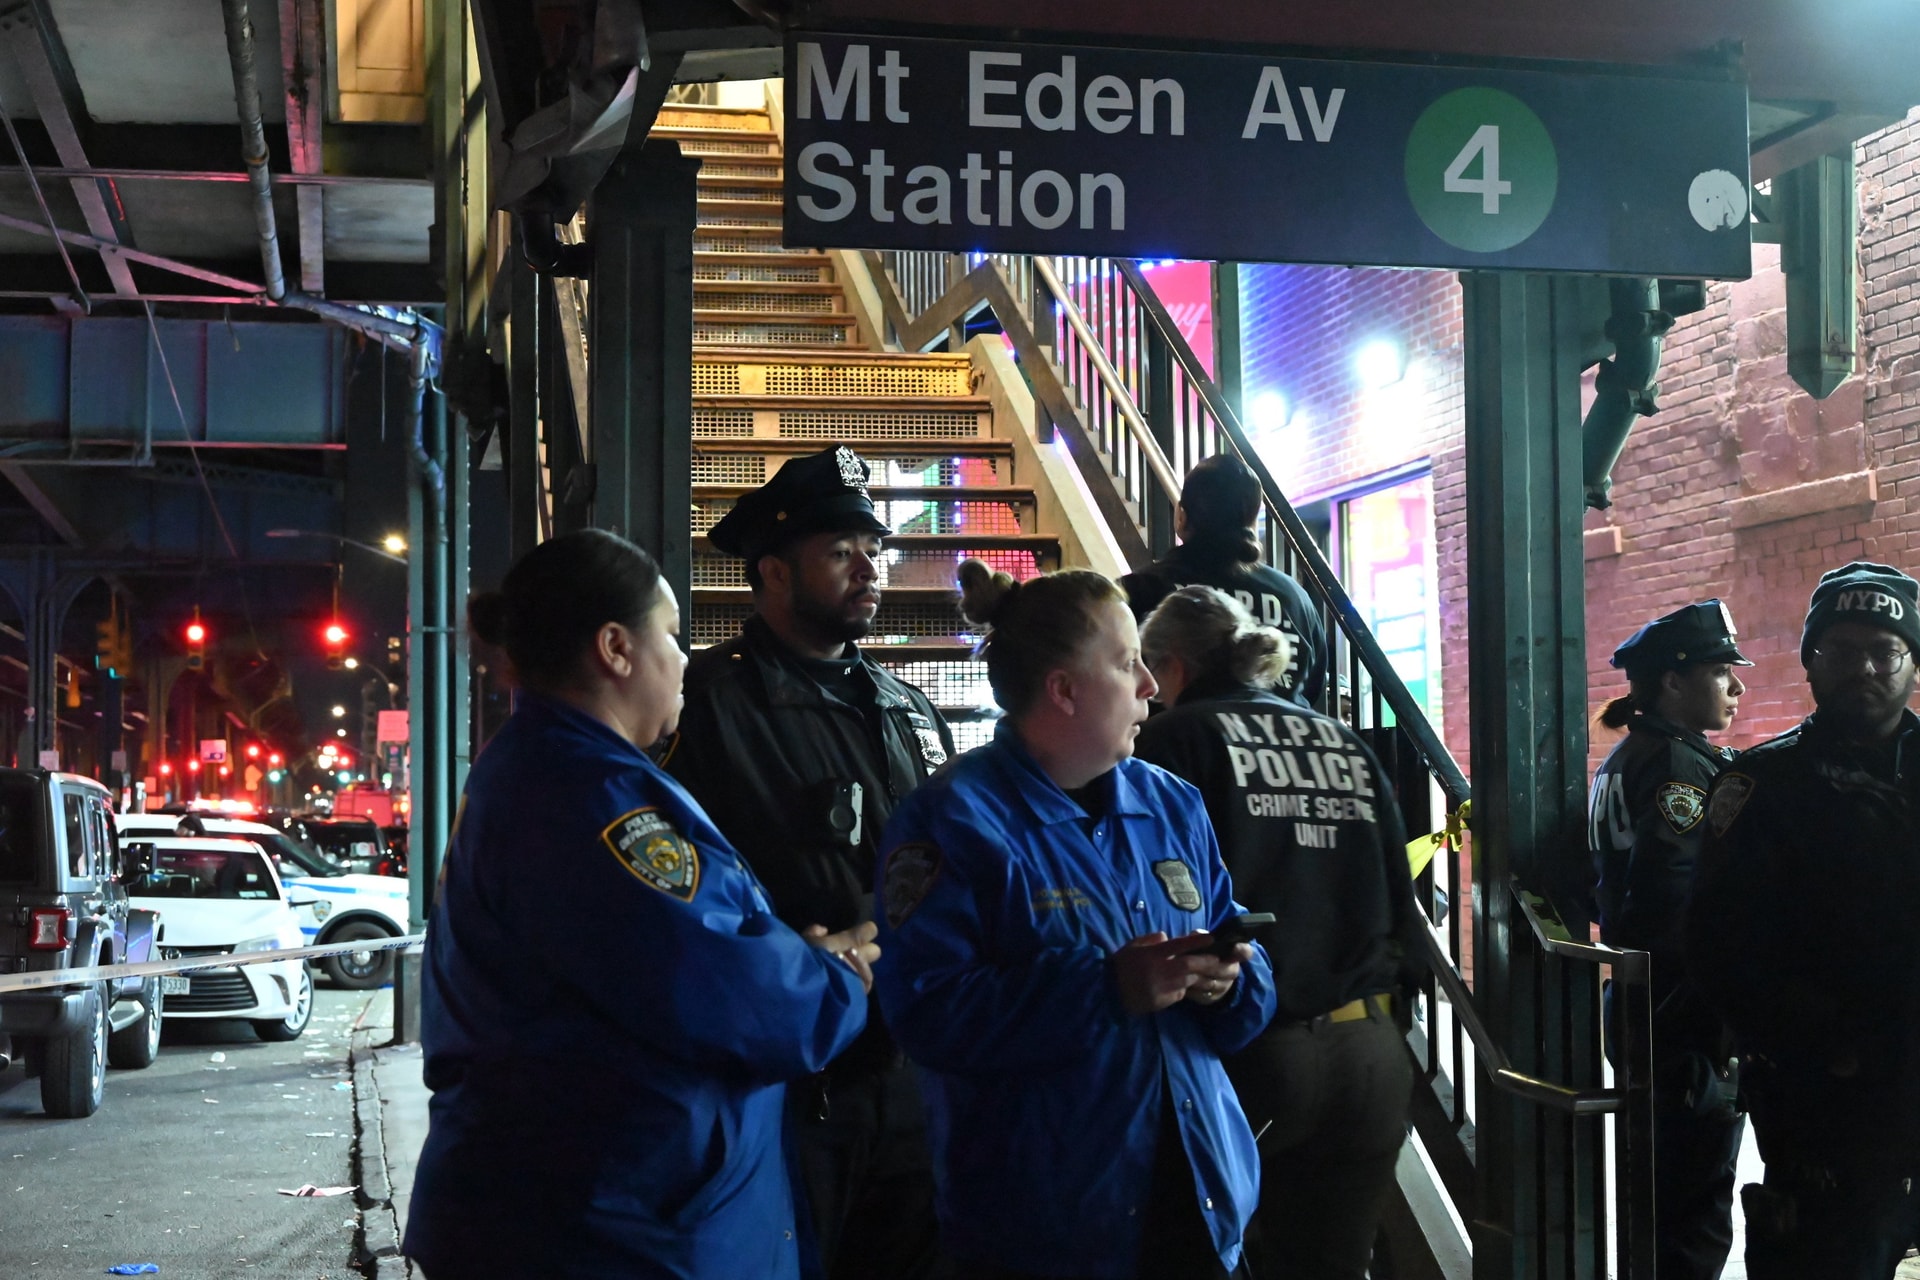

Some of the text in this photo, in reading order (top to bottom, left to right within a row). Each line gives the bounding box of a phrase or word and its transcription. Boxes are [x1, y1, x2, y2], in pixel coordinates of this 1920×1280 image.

[796, 42, 1346, 142] Mt Eden Av
[796, 141, 1126, 231] Station
[1444, 124, 1512, 214] 4
[1835, 589, 1904, 620] NYPD
[1216, 712, 1357, 751] N.Y.P.D.
[1226, 744, 1376, 798] POLICE
[1246, 793, 1377, 823] CRIME SCENE
[1294, 822, 1338, 849] UNIT
